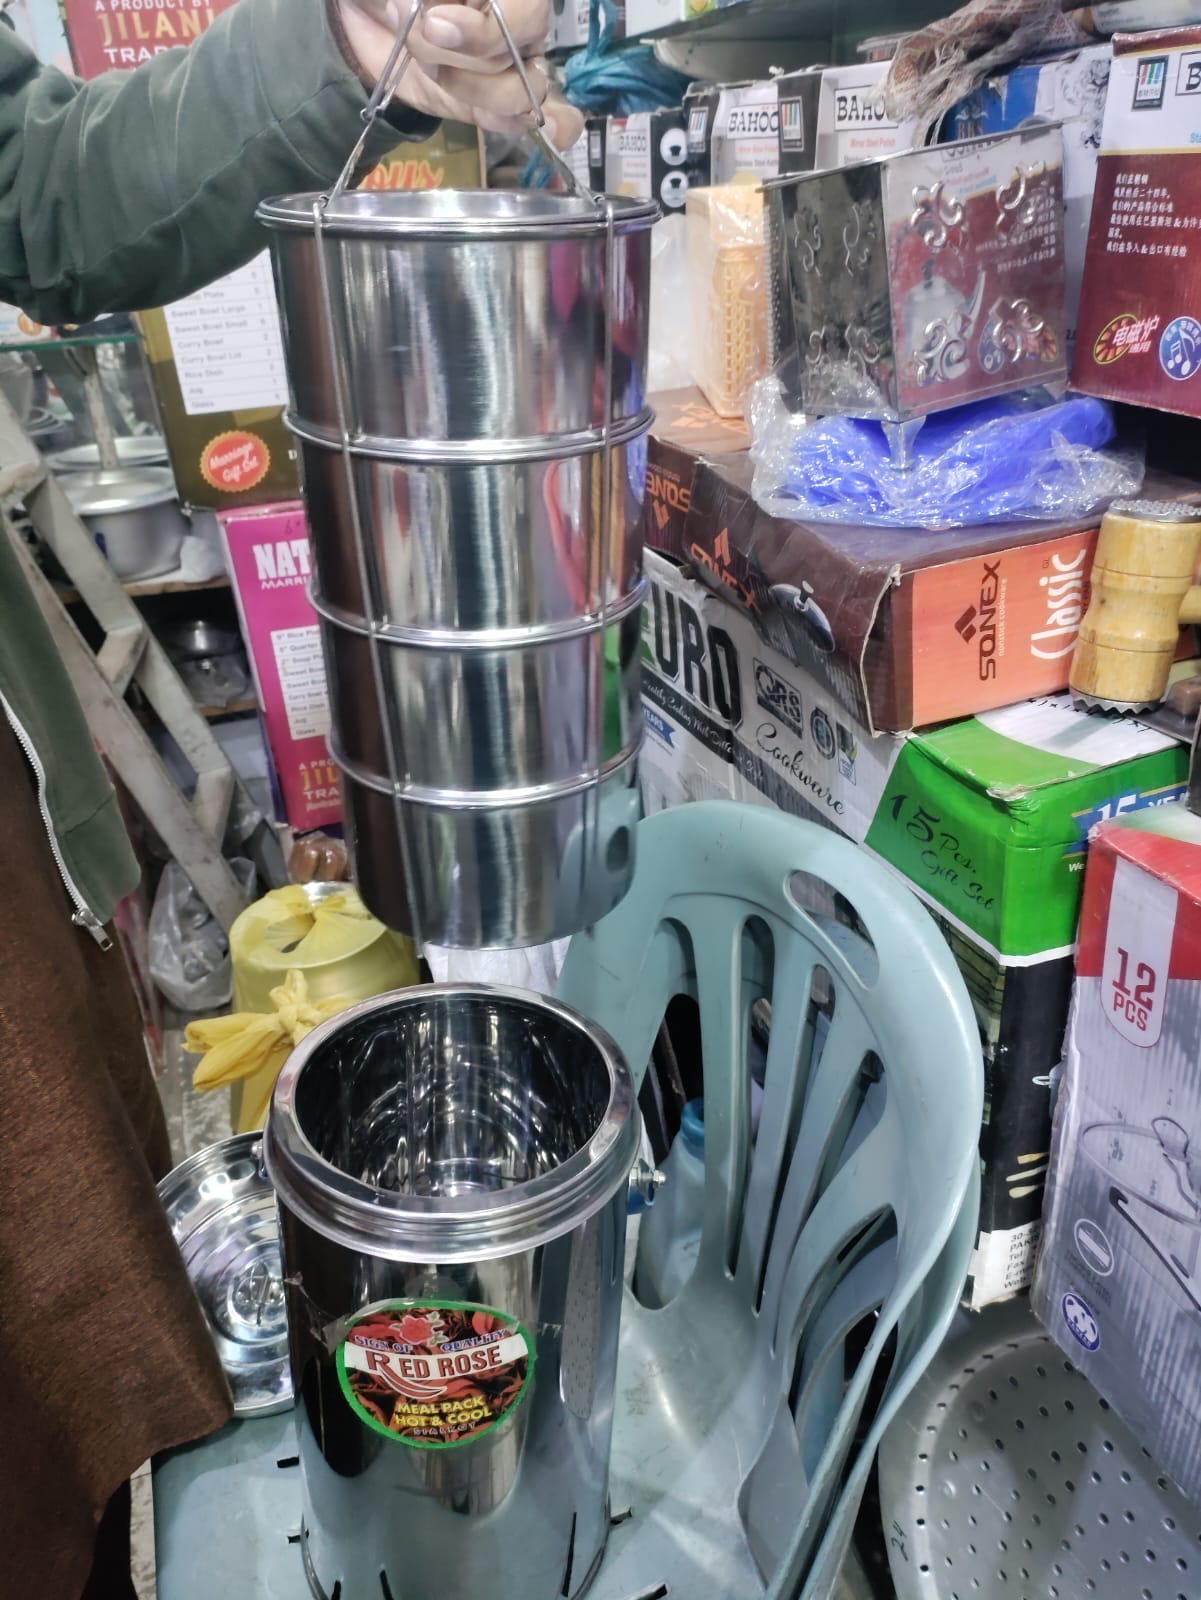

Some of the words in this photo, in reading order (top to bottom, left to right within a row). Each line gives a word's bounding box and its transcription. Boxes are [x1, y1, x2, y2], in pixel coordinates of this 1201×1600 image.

[96, 0, 105, 11] A
[111, 0, 183, 11] PRODUCT
[193, 0, 209, 8] BY
[97, 9, 214, 46] JILANI
[252, 539, 310, 581] NAT
[979, 559, 1001, 682] SONEX
[1031, 548, 1087, 660] Classic
[756, 722, 846, 815] Cookware
[890, 794, 941, 843] 15
[1112, 946, 1156, 1012] 12
[1113, 991, 1148, 1032] PCS
[437, 1346, 503, 1377] ROSE
[441, 1329, 507, 1353] QUALITY
[395, 1414, 428, 1428] HOT
[431, 1415, 443, 1427] &
[447, 1407, 493, 1424] COOL
